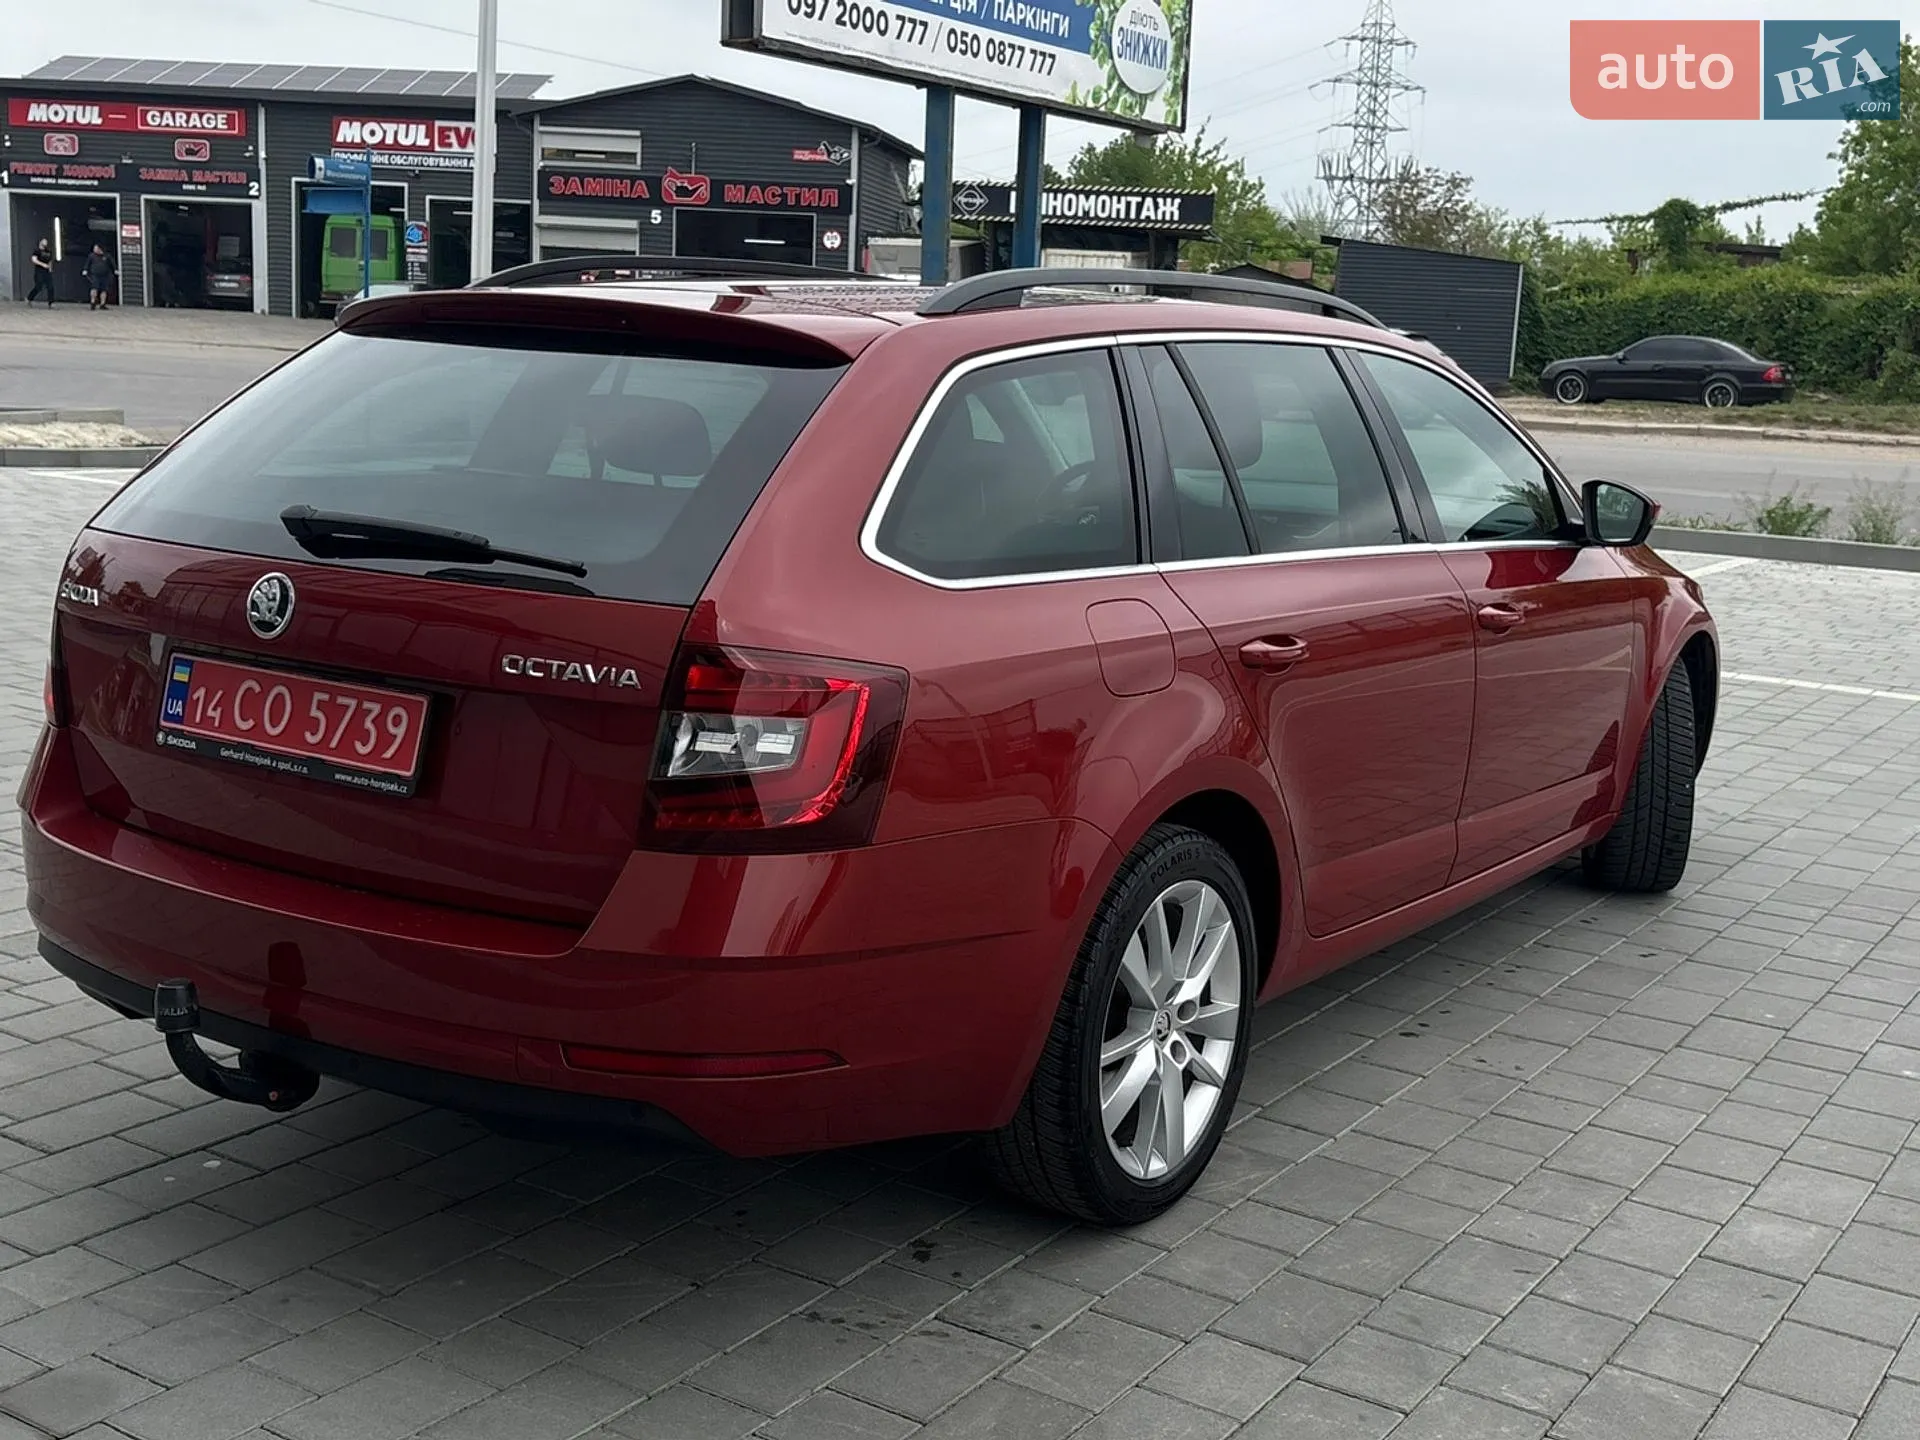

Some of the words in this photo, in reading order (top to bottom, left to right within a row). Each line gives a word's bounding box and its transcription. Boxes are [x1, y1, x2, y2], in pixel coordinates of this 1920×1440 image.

[994, 0, 1069, 38] ПАРКІНГИ
[1129, 5, 1159, 31] діють
[835, 0, 889, 37] 2000
[895, 14, 929, 45] 777
[946, 27, 981, 58] 050
[986, 37, 1026, 69] 0877
[1029, 48, 1057, 76] 777
[1117, 26, 1168, 71] ЗНИЖКИ
[27, 103, 103, 125] MOTUL
[146, 110, 228, 129] GARAGE
[336, 120, 431, 146] MOTUL
[437, 126, 475, 149] EV
[390, 153, 469, 168] ОБСЛУГОВУВАННЯ
[0, 170, 9, 185] 1
[248, 181, 260, 196] 2
[549, 175, 650, 199] ЗАМІНА
[724, 183, 839, 208] МАСТИЛ
[650, 209, 662, 224] 5
[501, 653, 642, 690] OCTAVIA
[166, 697, 183, 717] UA
[192, 686, 224, 728] 14
[234, 678, 293, 737] CO
[304, 690, 410, 760] 5739
[219, 746, 245, 762] Gerhard
[1150, 848, 1192, 884] POLARIS
